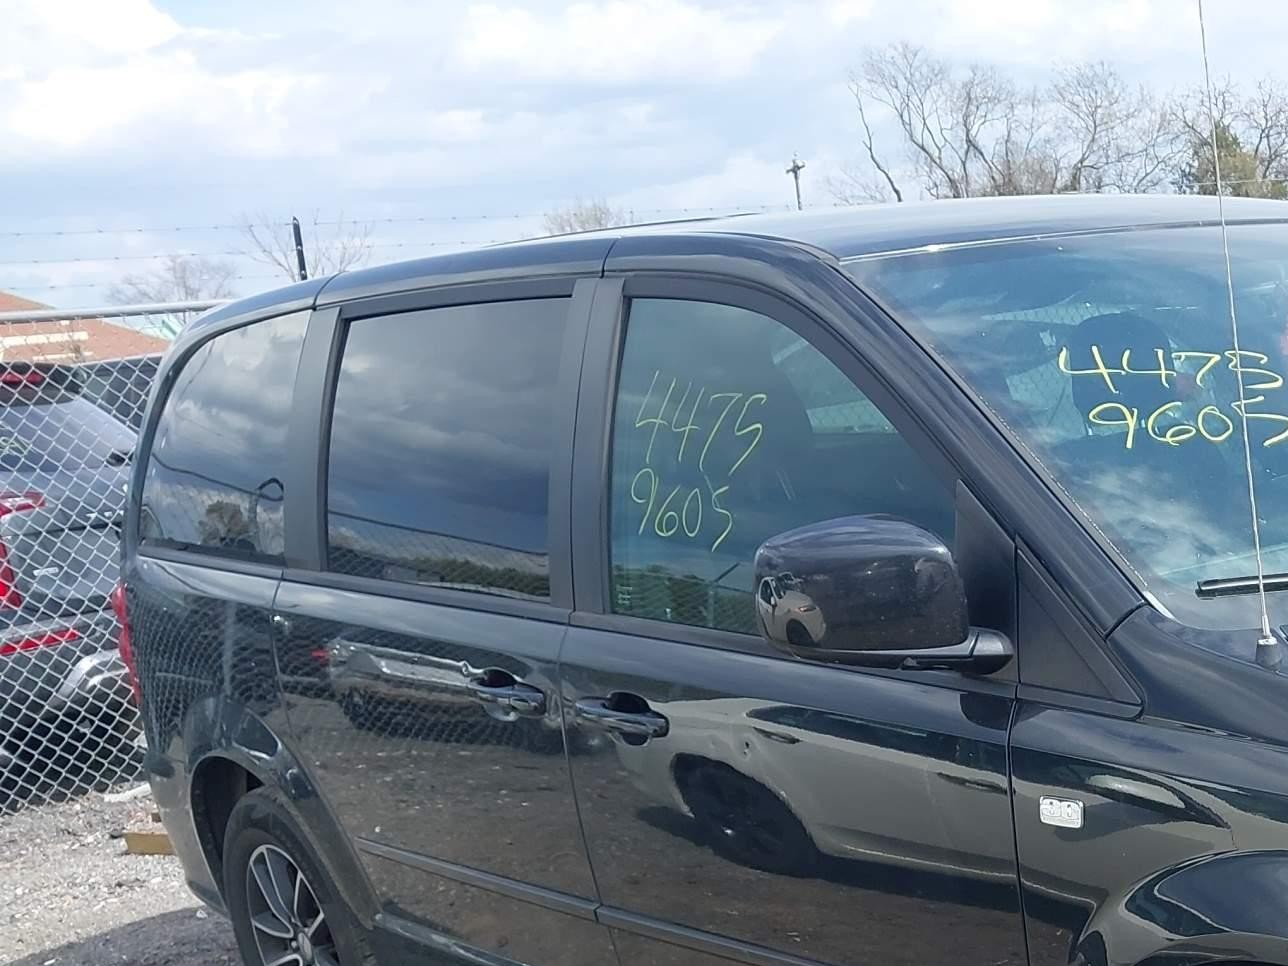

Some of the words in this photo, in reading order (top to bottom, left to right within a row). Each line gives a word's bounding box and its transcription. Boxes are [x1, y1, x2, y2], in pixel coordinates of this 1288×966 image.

[1057, 345, 1284, 395] 4475
[635, 369, 768, 477] 4475
[630, 467, 736, 552] 9605
